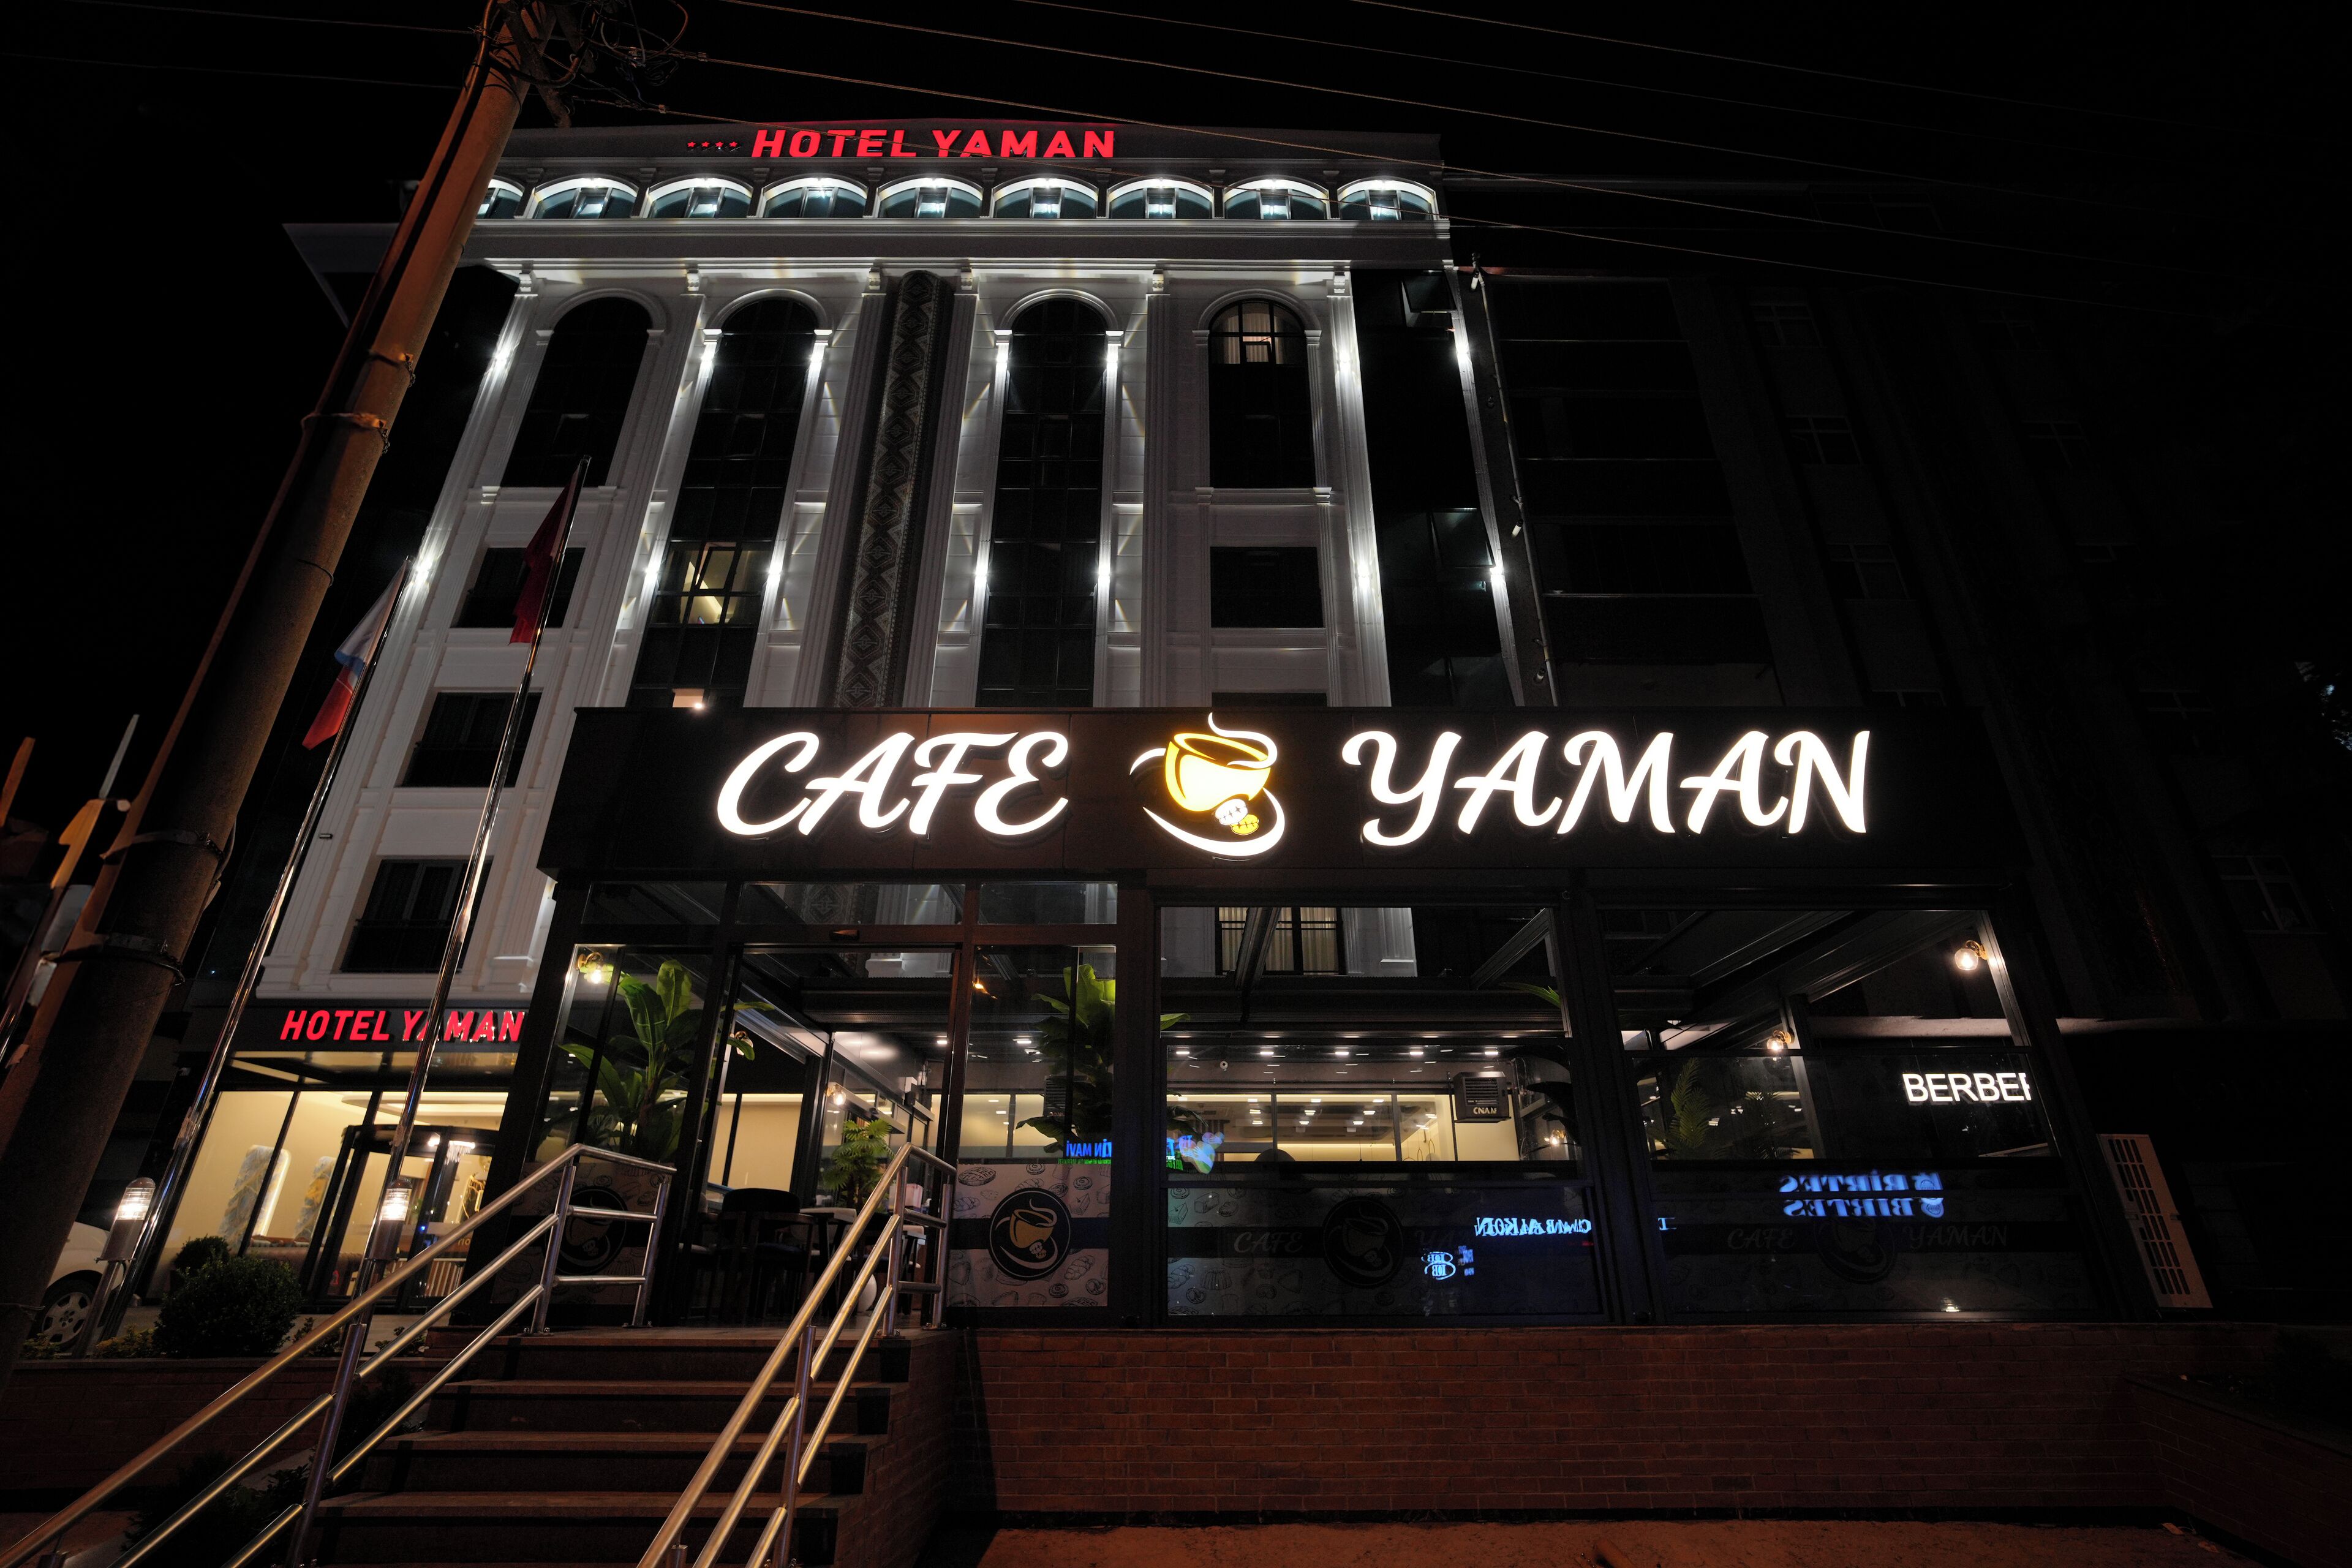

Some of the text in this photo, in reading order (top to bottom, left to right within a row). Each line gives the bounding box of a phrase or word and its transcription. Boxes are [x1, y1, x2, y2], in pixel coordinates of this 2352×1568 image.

[751, 129, 1115, 158] HOTEL YAMAN
[715, 729, 1872, 847] CAFE YAMAN
[280, 1010, 390, 1041] HOTEL
[1234, 1231, 1303, 1254] CAFE
[1727, 1226, 2007, 1250] CAFE YAMAN
